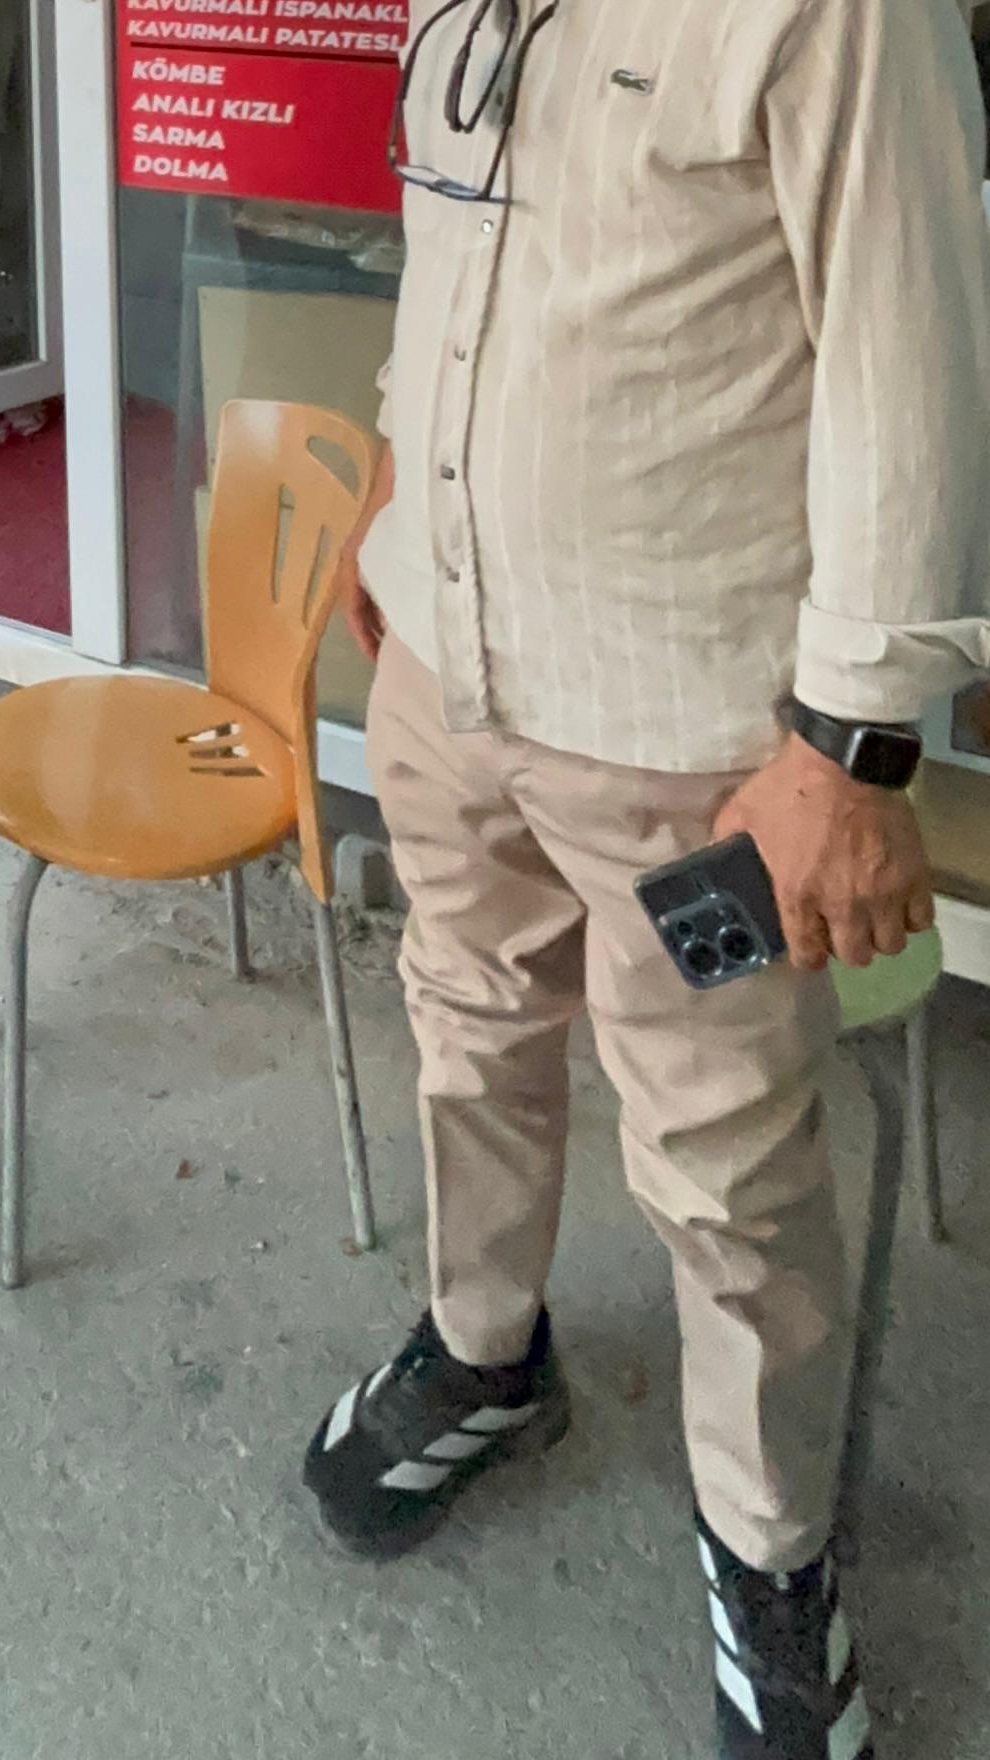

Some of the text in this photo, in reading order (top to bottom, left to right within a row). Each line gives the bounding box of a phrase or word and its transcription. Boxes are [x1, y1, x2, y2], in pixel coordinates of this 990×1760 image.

[274, 1, 408, 23] ISPANAKL
[126, 20, 404, 52] KAVURMALI PATATESL
[132, 57, 226, 86] KÖMBE
[132, 93, 296, 124] ANALI KIZLI
[132, 123, 226, 150] SARMA
[134, 154, 228, 182] DOLMA
